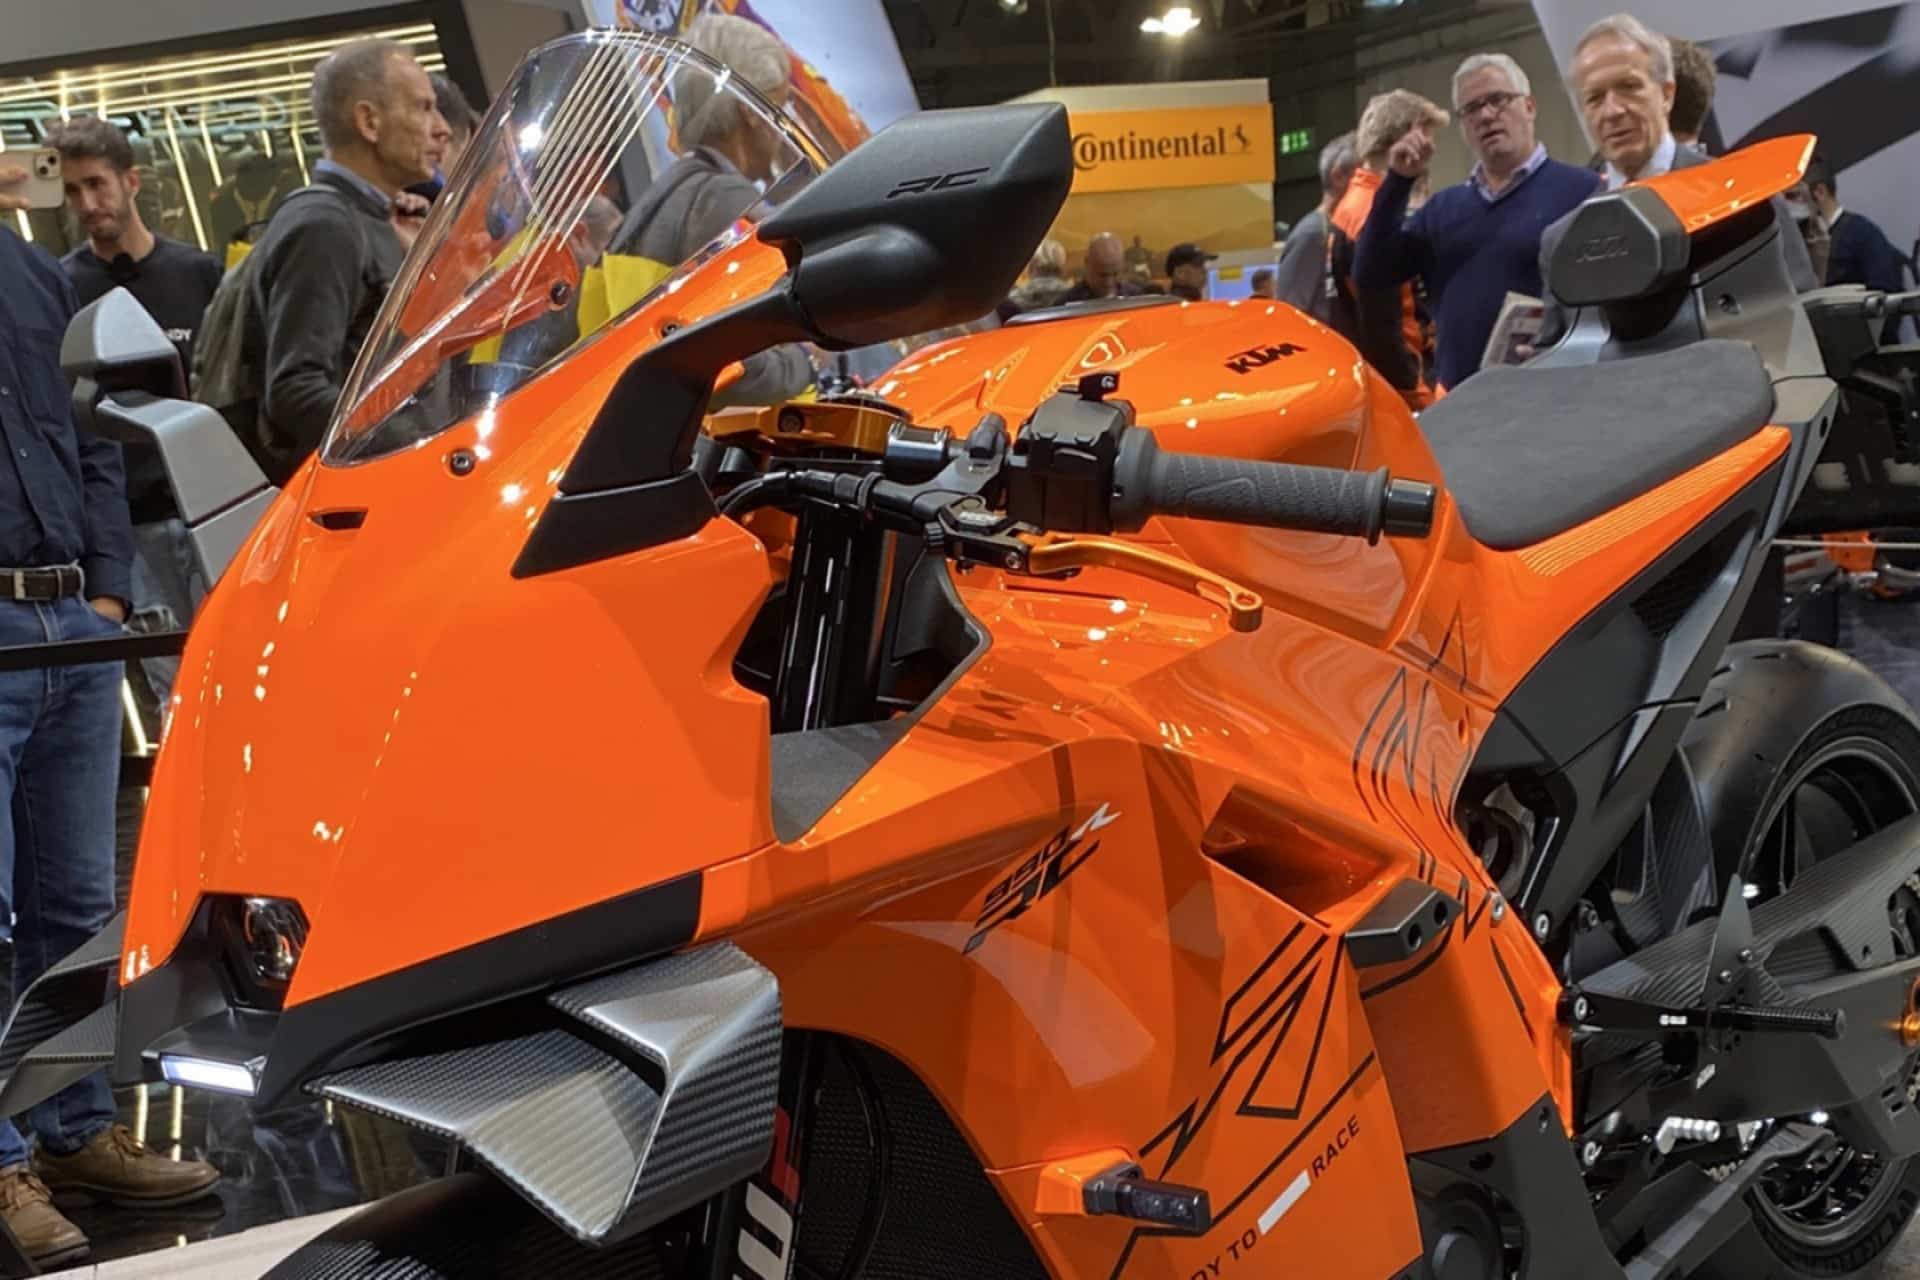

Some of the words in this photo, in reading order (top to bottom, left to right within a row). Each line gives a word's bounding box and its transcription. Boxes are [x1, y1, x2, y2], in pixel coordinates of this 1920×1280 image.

[1072, 127, 1226, 170] Continental
[886, 167, 991, 198] RC
[1223, 343, 1308, 375] KTM
[1226, 1228, 1258, 1261] TO
[1311, 1114, 1361, 1179] RACE
